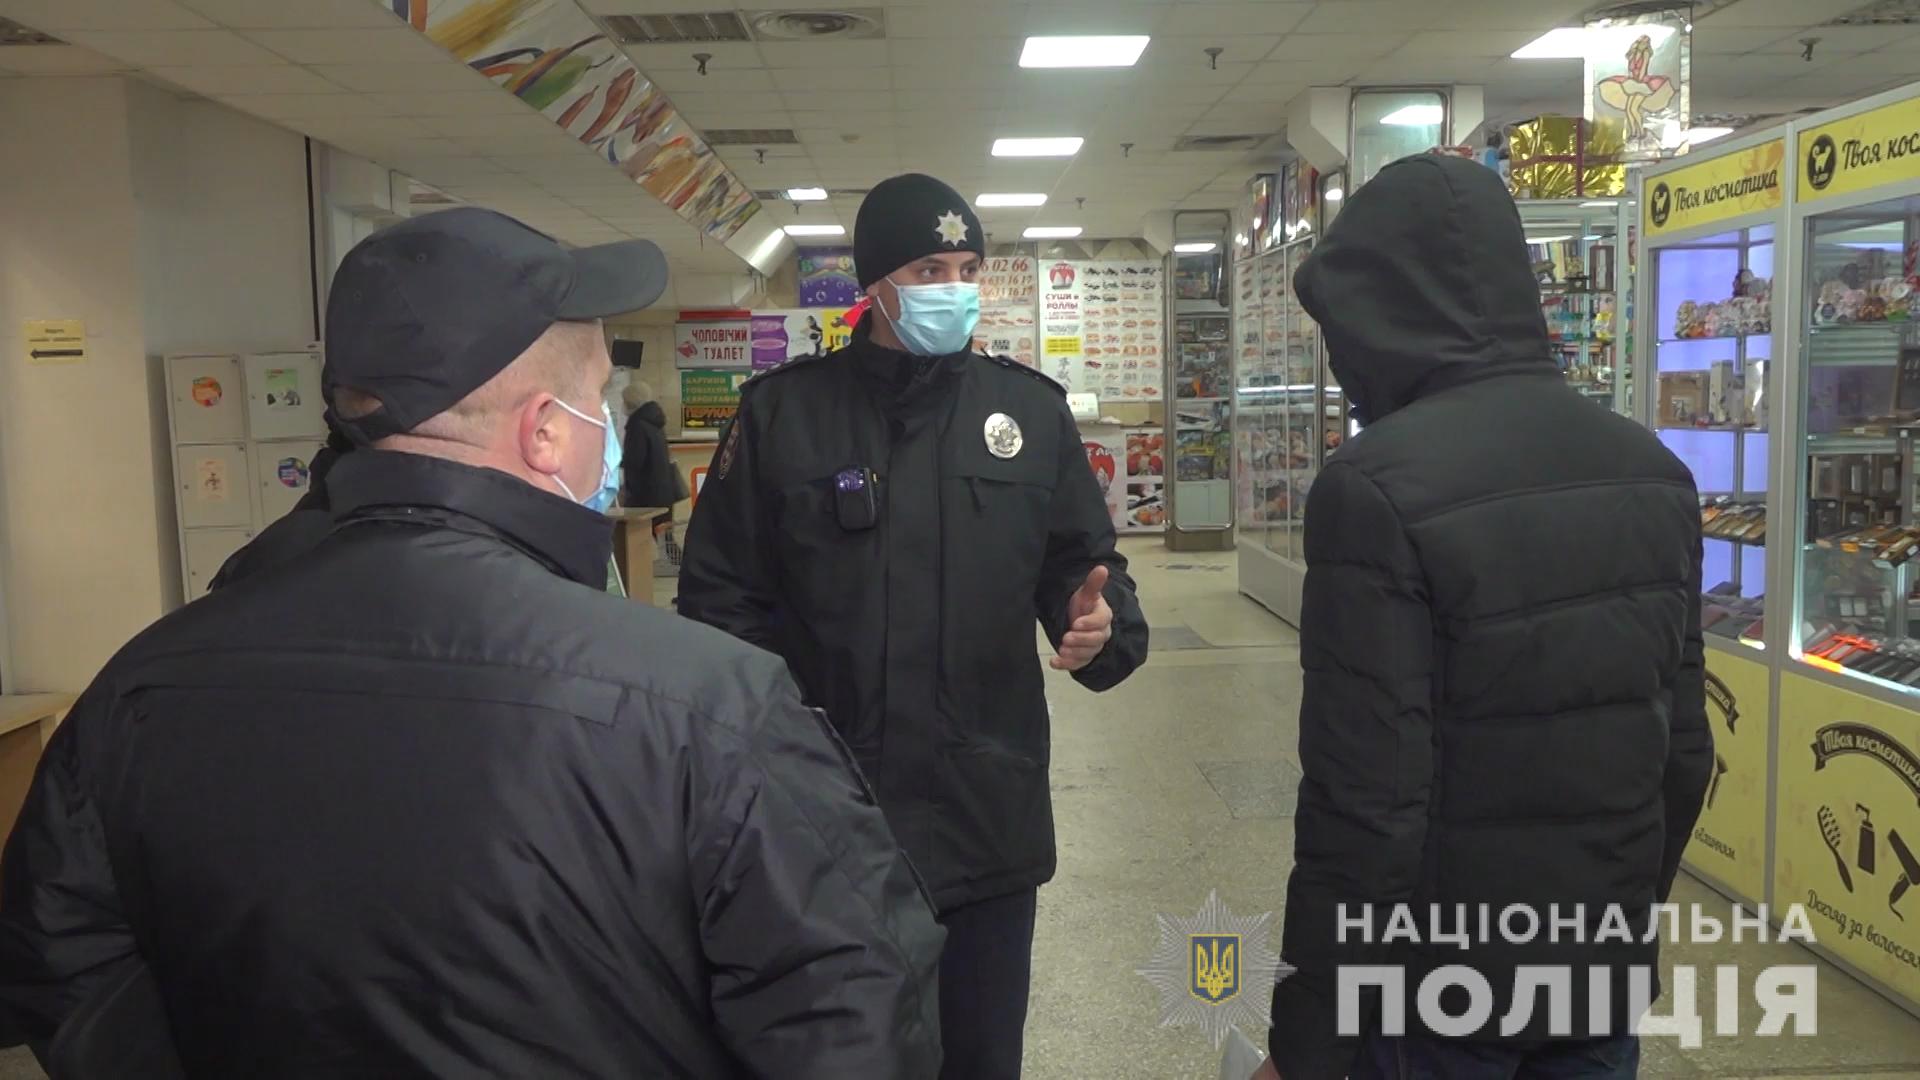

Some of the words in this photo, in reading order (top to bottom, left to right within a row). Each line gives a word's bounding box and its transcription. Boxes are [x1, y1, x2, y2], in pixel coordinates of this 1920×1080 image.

[1842, 138, 1881, 170] Твоя
[1887, 131, 1920, 161] кос
[1673, 187, 1700, 212] Твоя
[1702, 168, 1778, 206] косметика
[991, 259, 1009, 272] 02
[1012, 257, 1028, 272] 66
[691, 327, 748, 343] ЧОЛОВІЧИЙ
[703, 347, 744, 360] ТУАЛЕТ
[1822, 729, 1854, 753] Твоя
[1807, 888, 1848, 936] Догляд
[1847, 919, 1864, 941] за
[1866, 923, 1920, 969] волосся
